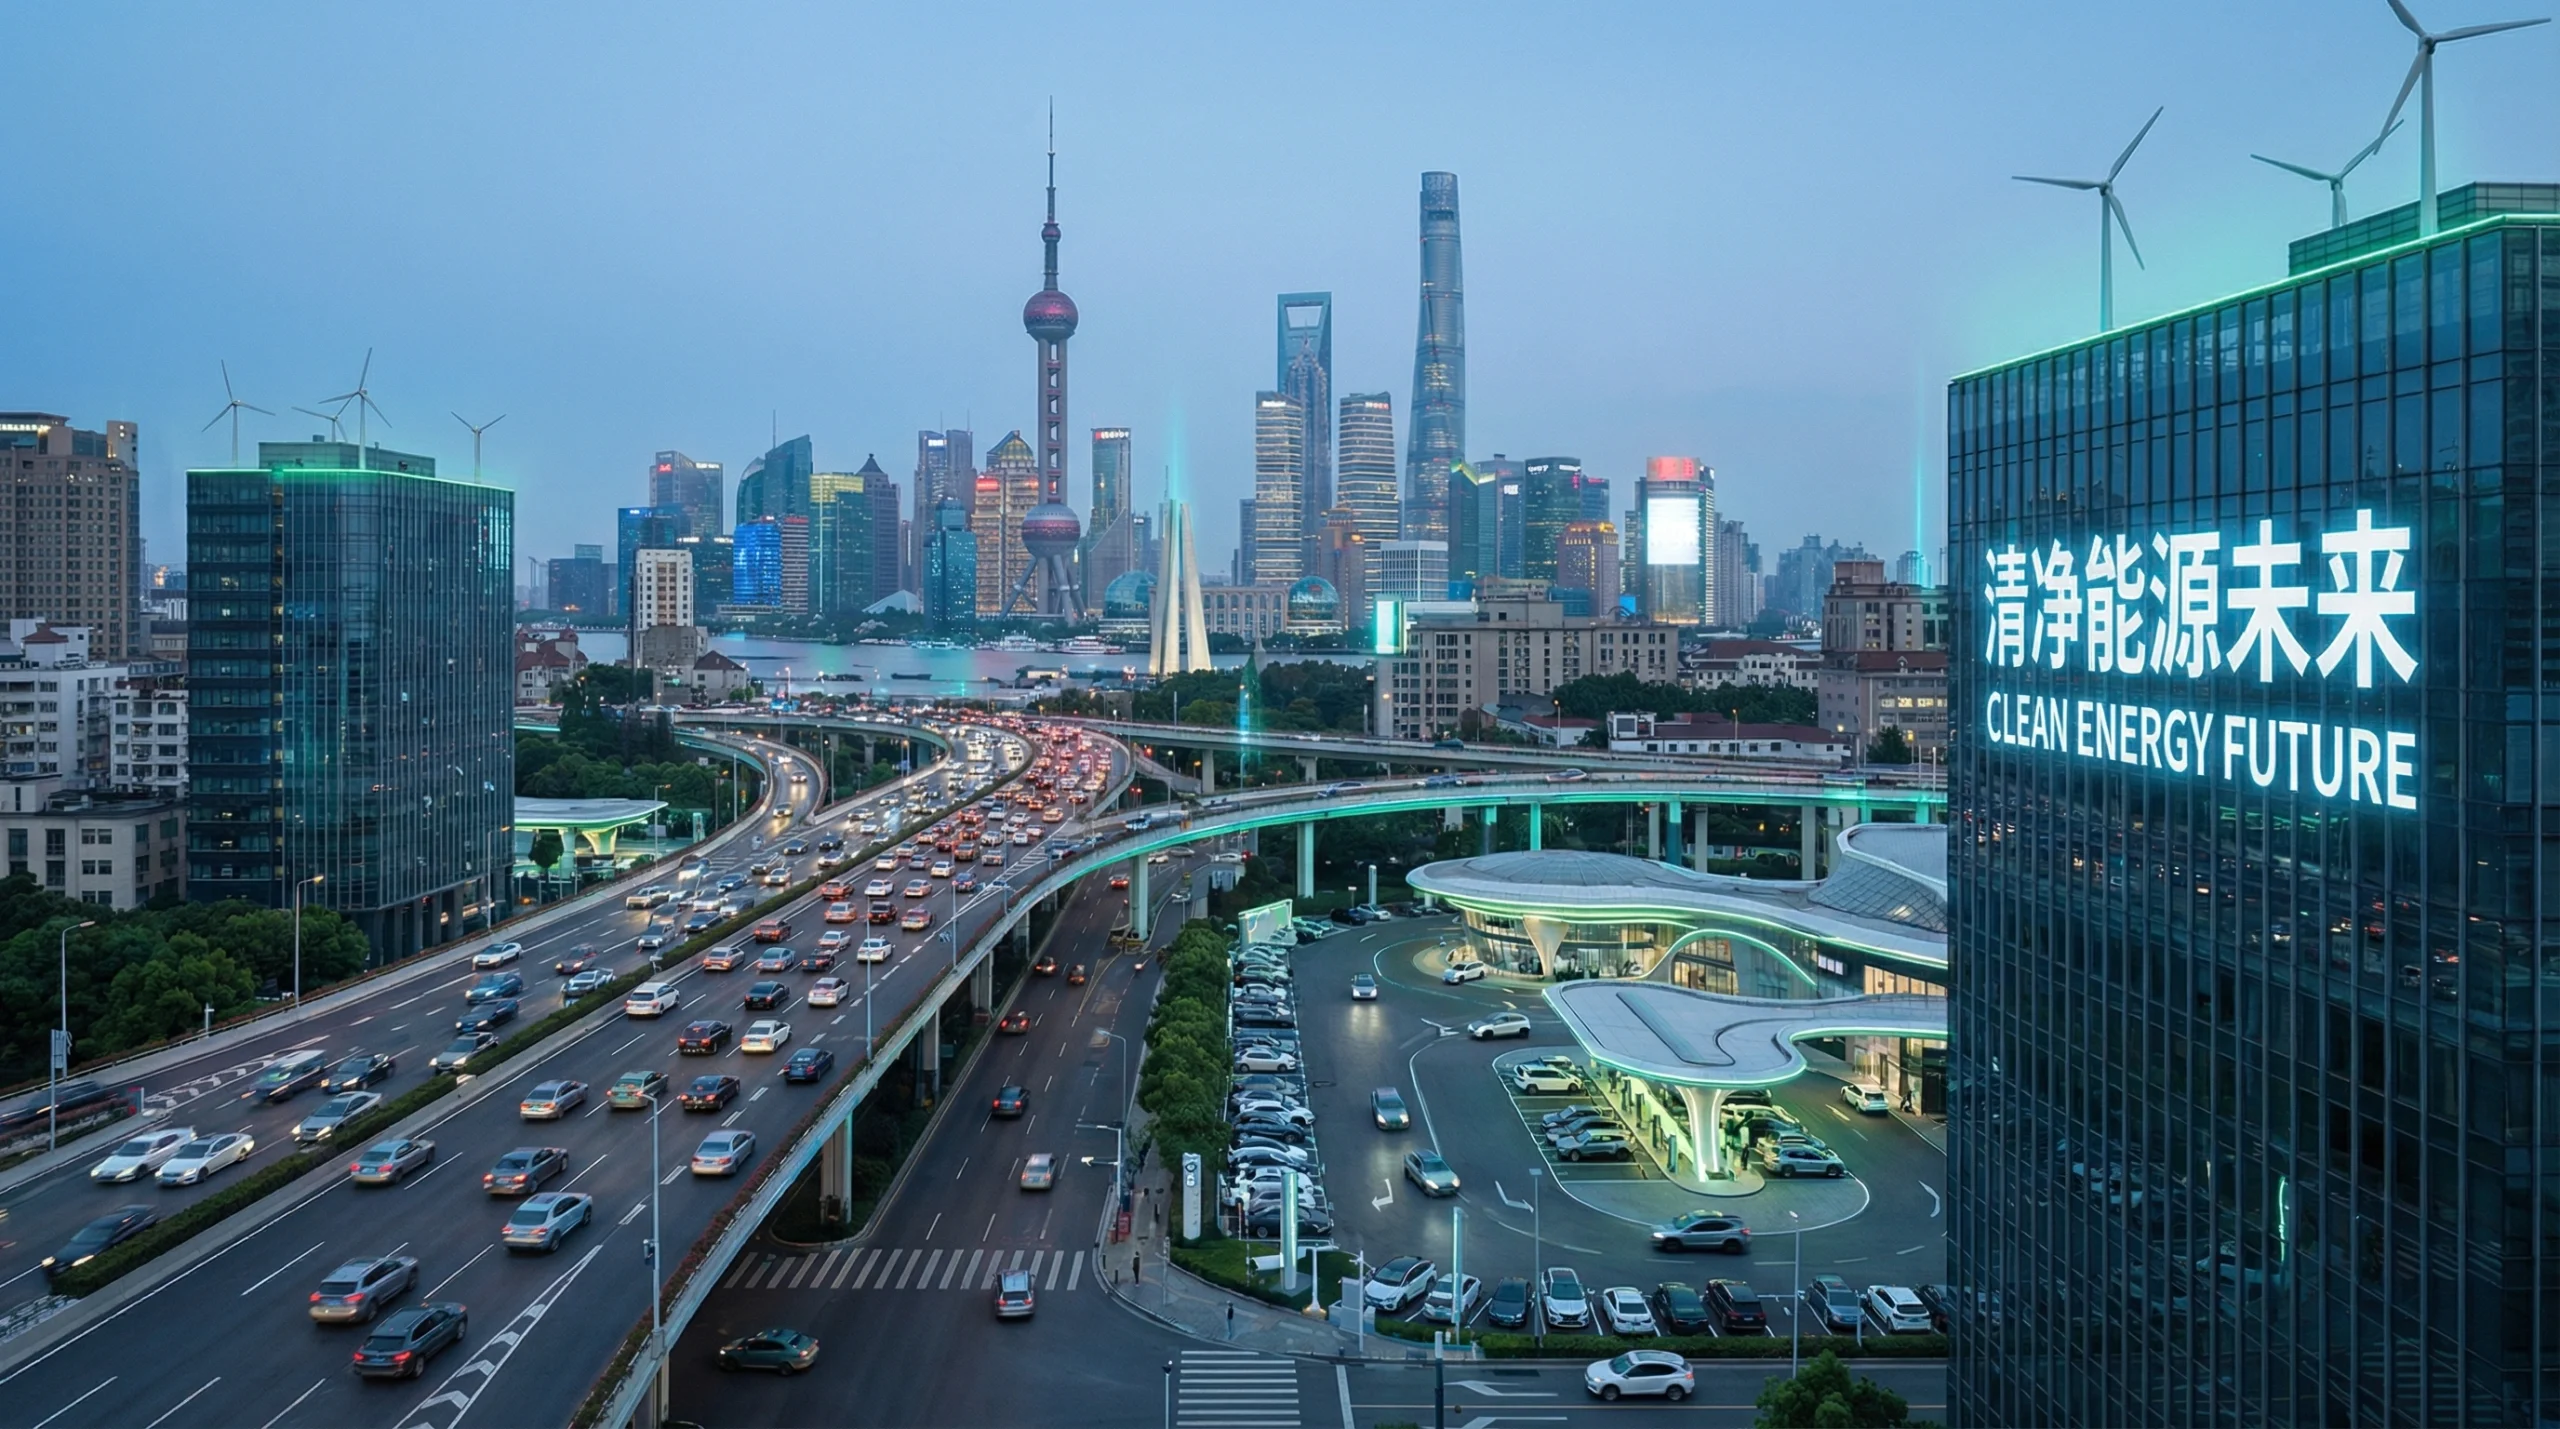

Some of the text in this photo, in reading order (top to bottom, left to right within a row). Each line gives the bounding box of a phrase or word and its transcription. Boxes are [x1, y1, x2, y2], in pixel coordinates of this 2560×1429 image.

[1984, 509, 2419, 688] 清净能源未来
[1986, 691, 2417, 810] CLEAN ENERGY FUTURE
